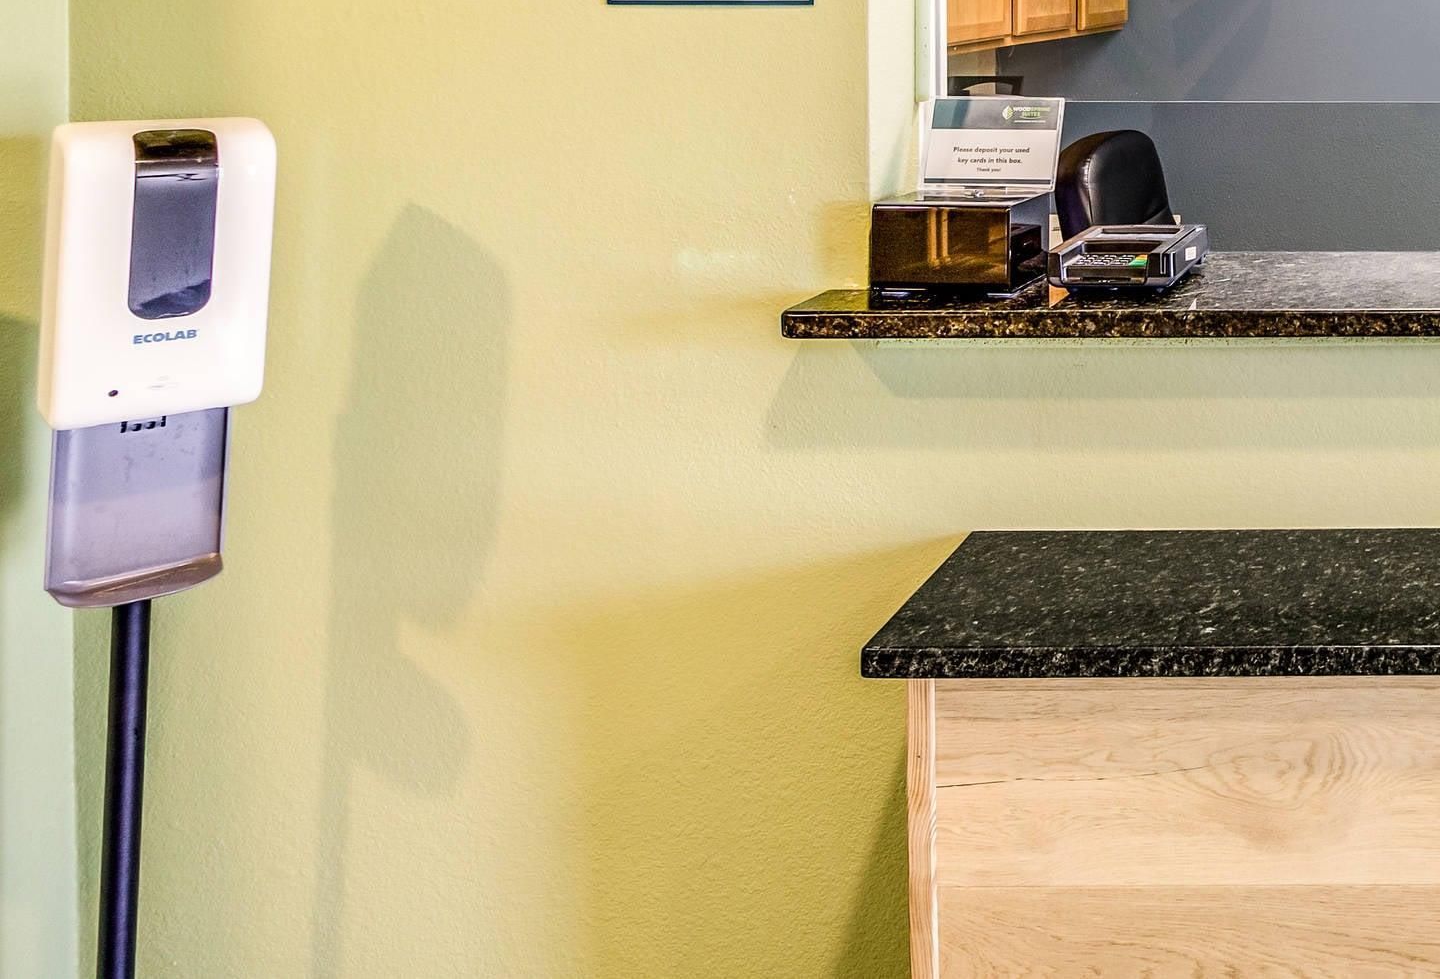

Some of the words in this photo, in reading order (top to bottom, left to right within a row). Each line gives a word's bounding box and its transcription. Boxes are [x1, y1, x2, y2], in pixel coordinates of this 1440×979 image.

[974, 146, 998, 154] deposit
[999, 147, 1014, 155] your
[957, 157, 969, 165] key
[133, 329, 198, 345] ECOLAB
